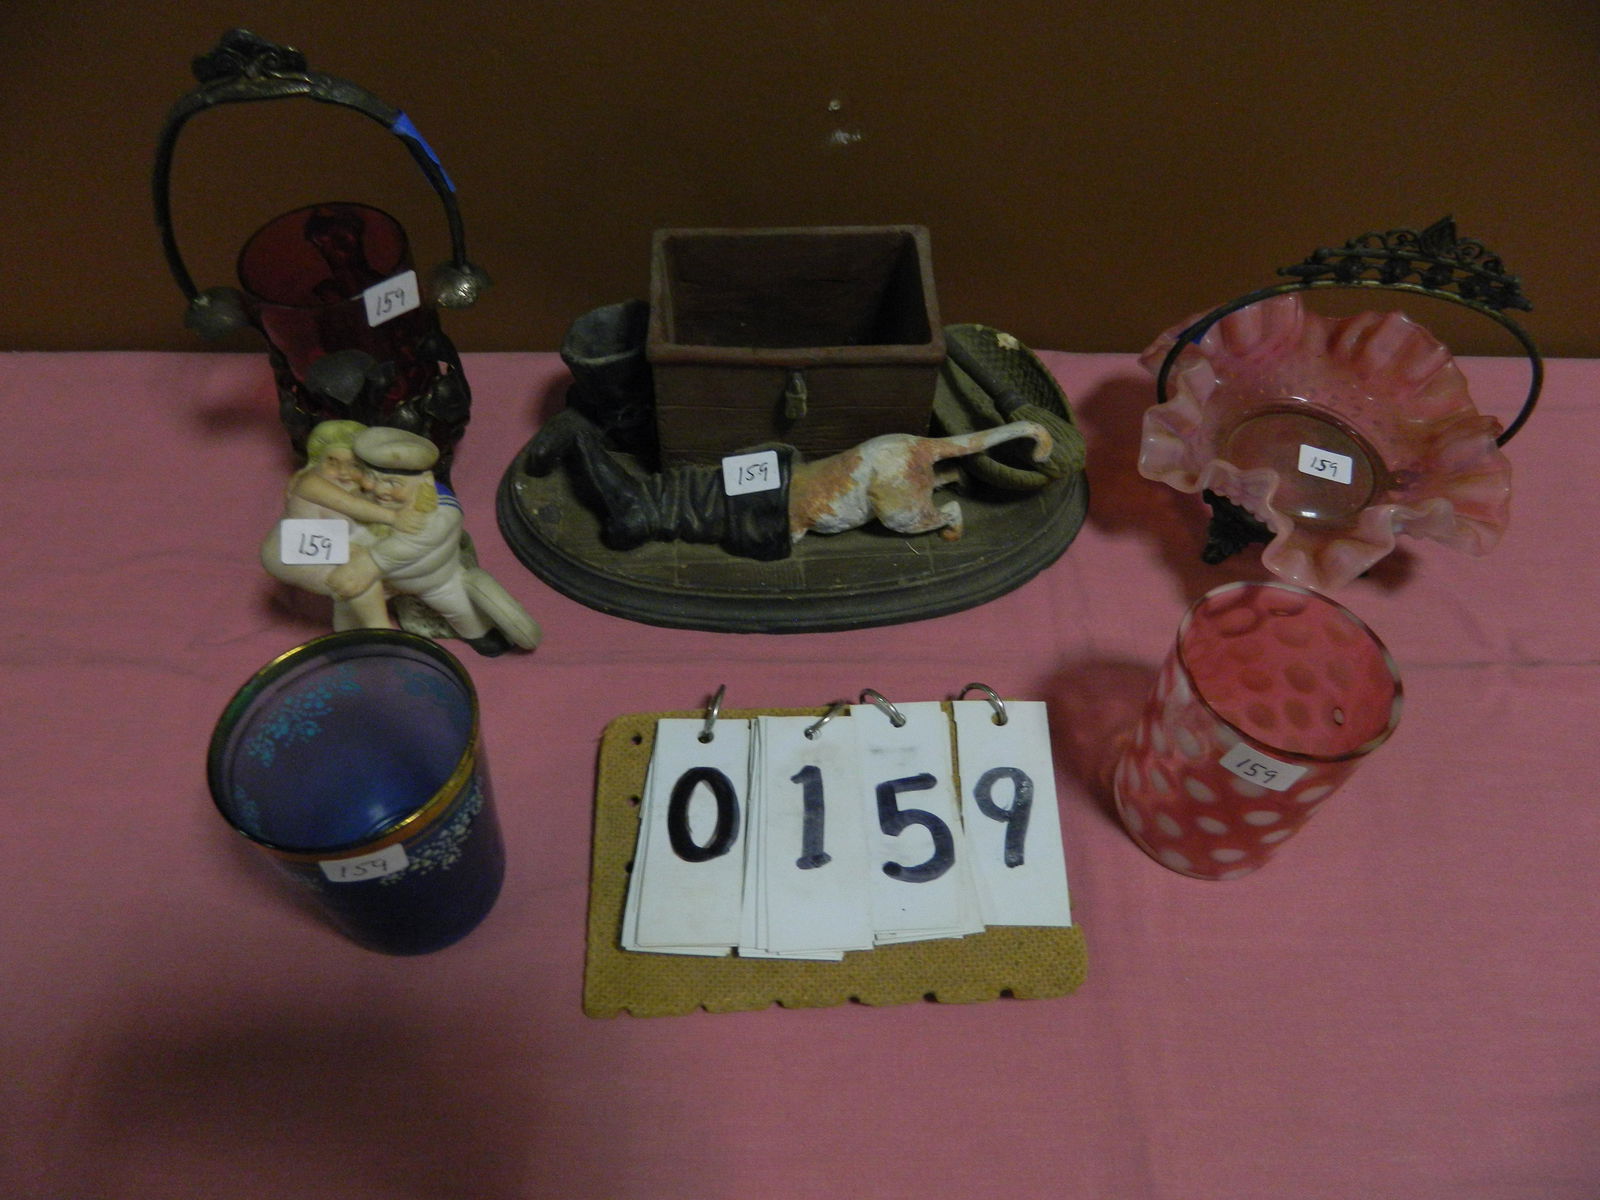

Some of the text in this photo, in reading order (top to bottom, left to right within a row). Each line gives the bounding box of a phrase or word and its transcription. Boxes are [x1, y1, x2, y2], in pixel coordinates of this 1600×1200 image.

[377, 288, 405, 316] 159
[739, 462, 768, 485] 159
[1310, 457, 1338, 477] 159
[299, 533, 332, 560] 159
[1237, 759, 1278, 783] 159
[668, 765, 1034, 882] 0159
[340, 859, 388, 877] 159
